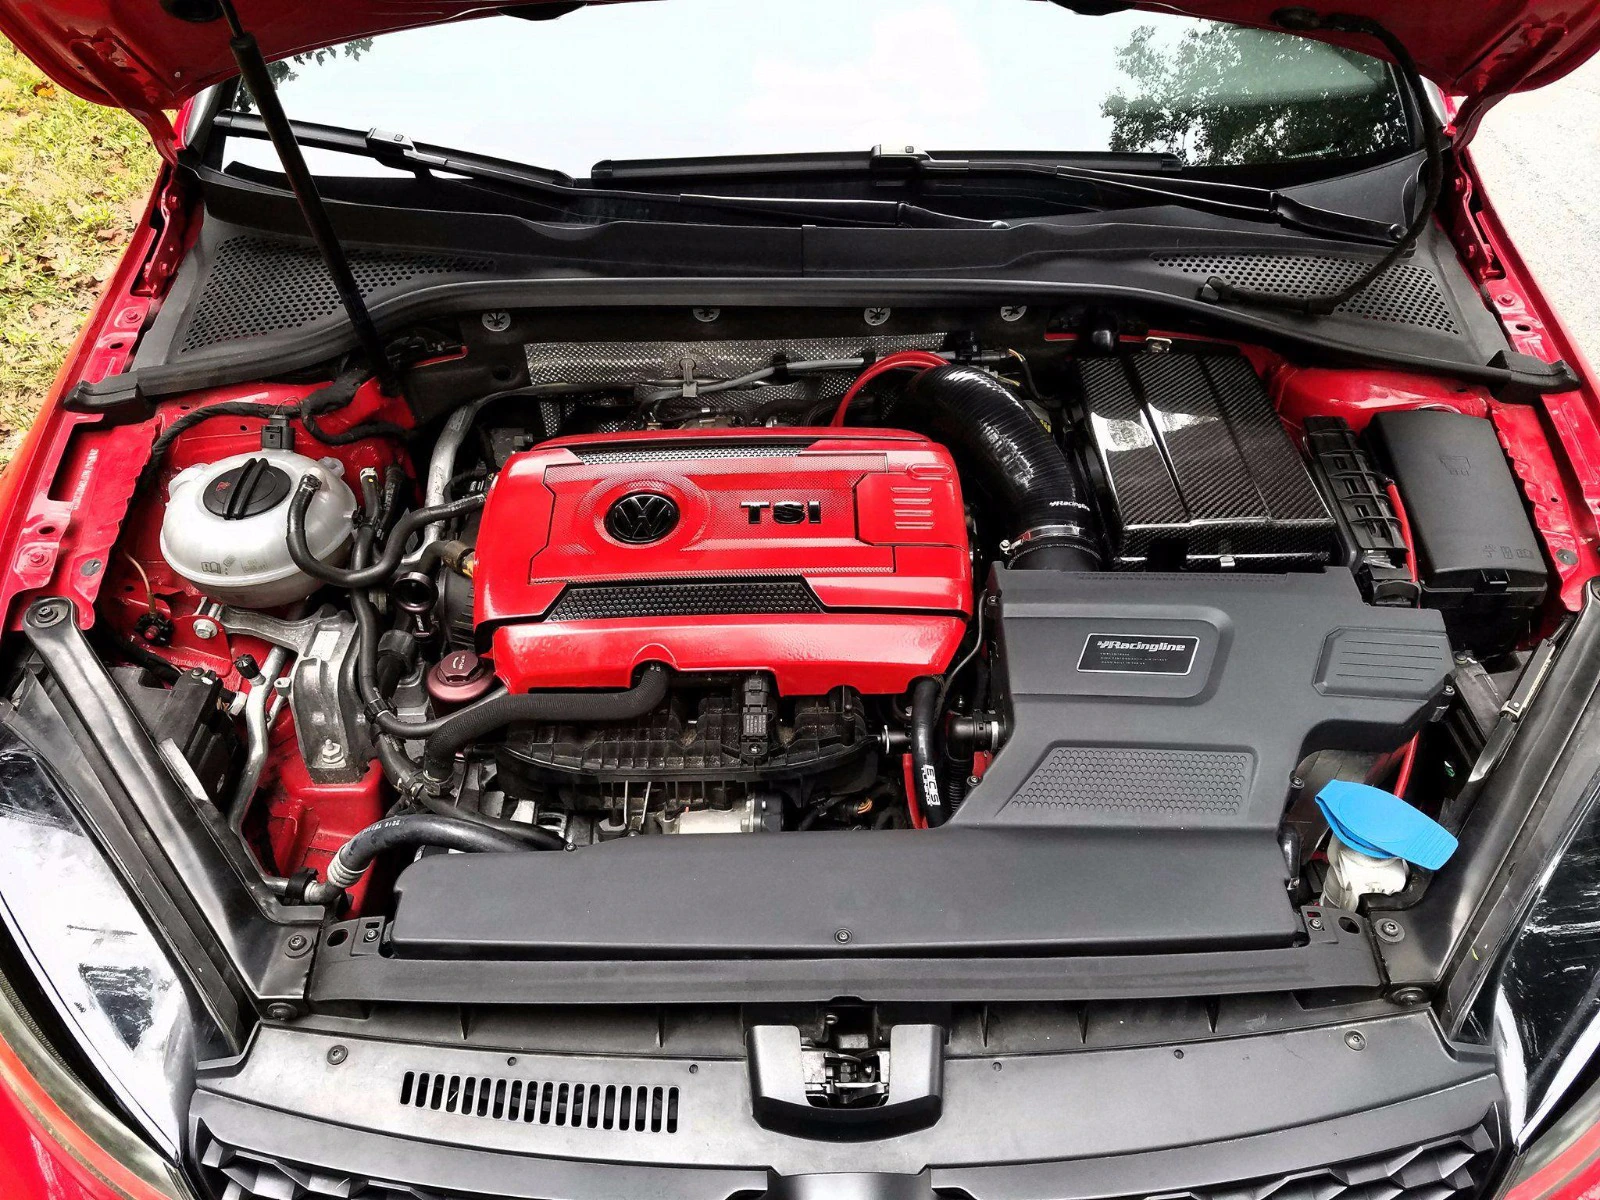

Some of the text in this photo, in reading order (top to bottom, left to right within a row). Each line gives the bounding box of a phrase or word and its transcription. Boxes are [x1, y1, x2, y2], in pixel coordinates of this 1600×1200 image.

[740, 500, 822, 524] TSI
[1107, 641, 1186, 652] Racingline
[926, 765, 941, 805] ECS
